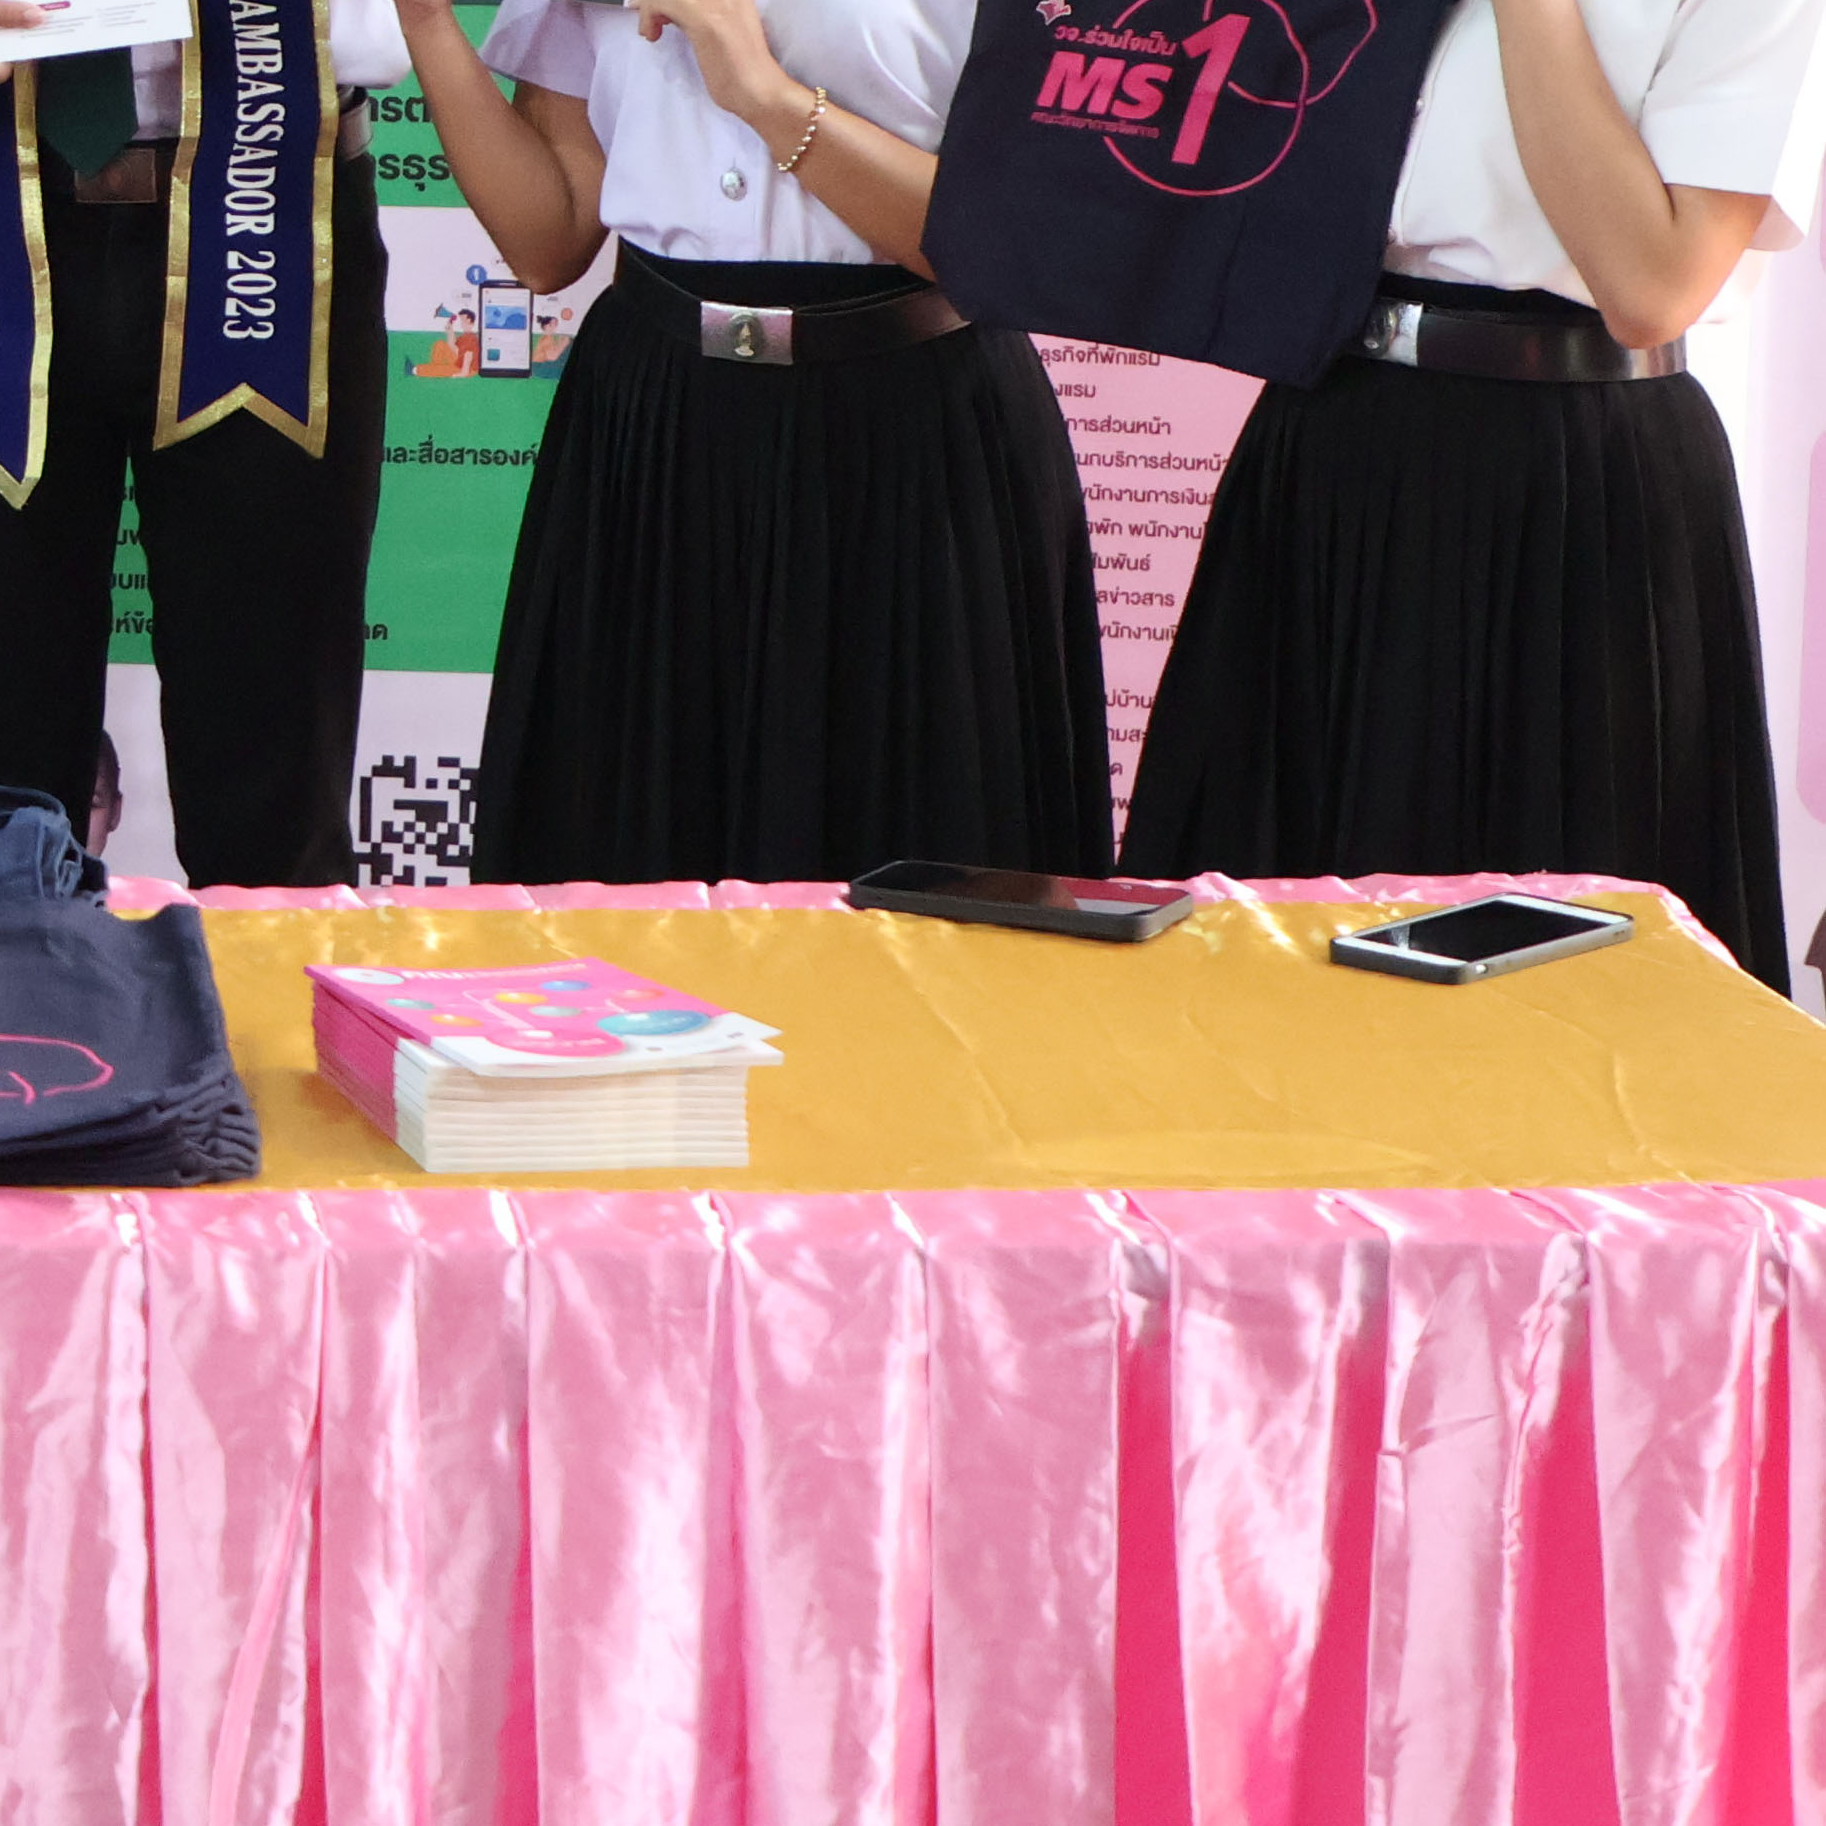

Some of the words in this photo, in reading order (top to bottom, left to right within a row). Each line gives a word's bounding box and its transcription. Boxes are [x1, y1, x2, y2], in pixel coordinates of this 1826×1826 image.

[1036, 50, 1173, 120] MS
[1171, 13, 1251, 166] 1
[222, 249, 277, 340] 2023
[1129, 520, 1207, 540] พนักงาน
[1093, 552, 1151, 571] มพันธ์
